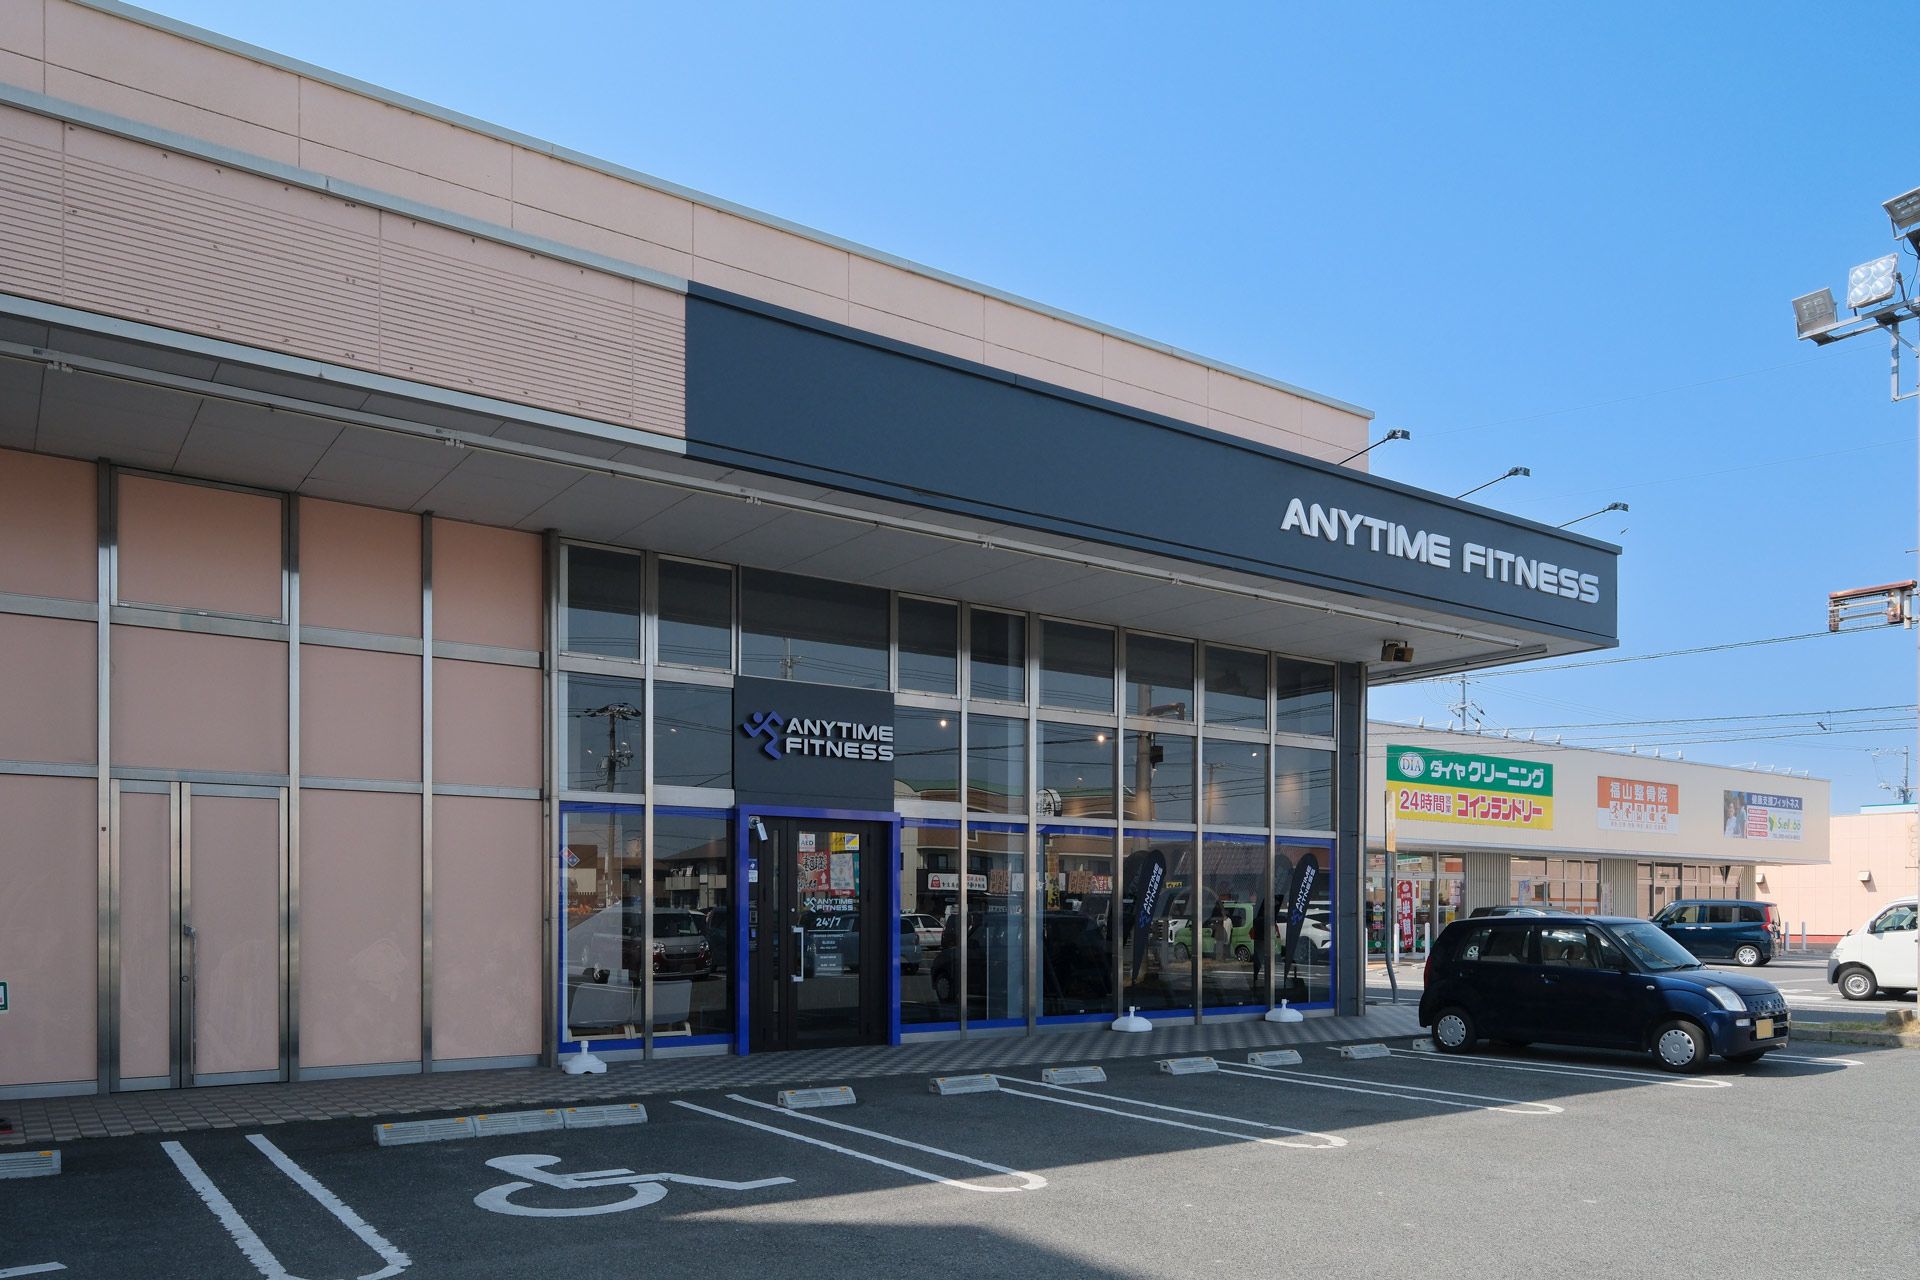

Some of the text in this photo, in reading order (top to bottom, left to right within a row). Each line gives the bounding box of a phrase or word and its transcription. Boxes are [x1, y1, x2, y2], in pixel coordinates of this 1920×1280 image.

[1280, 498, 1600, 604] ANYTIME FITNESS
[786, 717, 894, 742] ANYTIME
[785, 737, 894, 761] FITNESS
[1402, 758, 1421, 772] DIA
[1430, 760, 1544, 789] ダイヤクリーニング
[1457, 793, 1543, 822] コインランドリー
[1143, 862, 1160, 911] ANYTIME
[1146, 867, 1163, 915] FITNESS
[1295, 864, 1312, 910] ANYTIME
[1298, 868, 1316, 913] FITNESS
